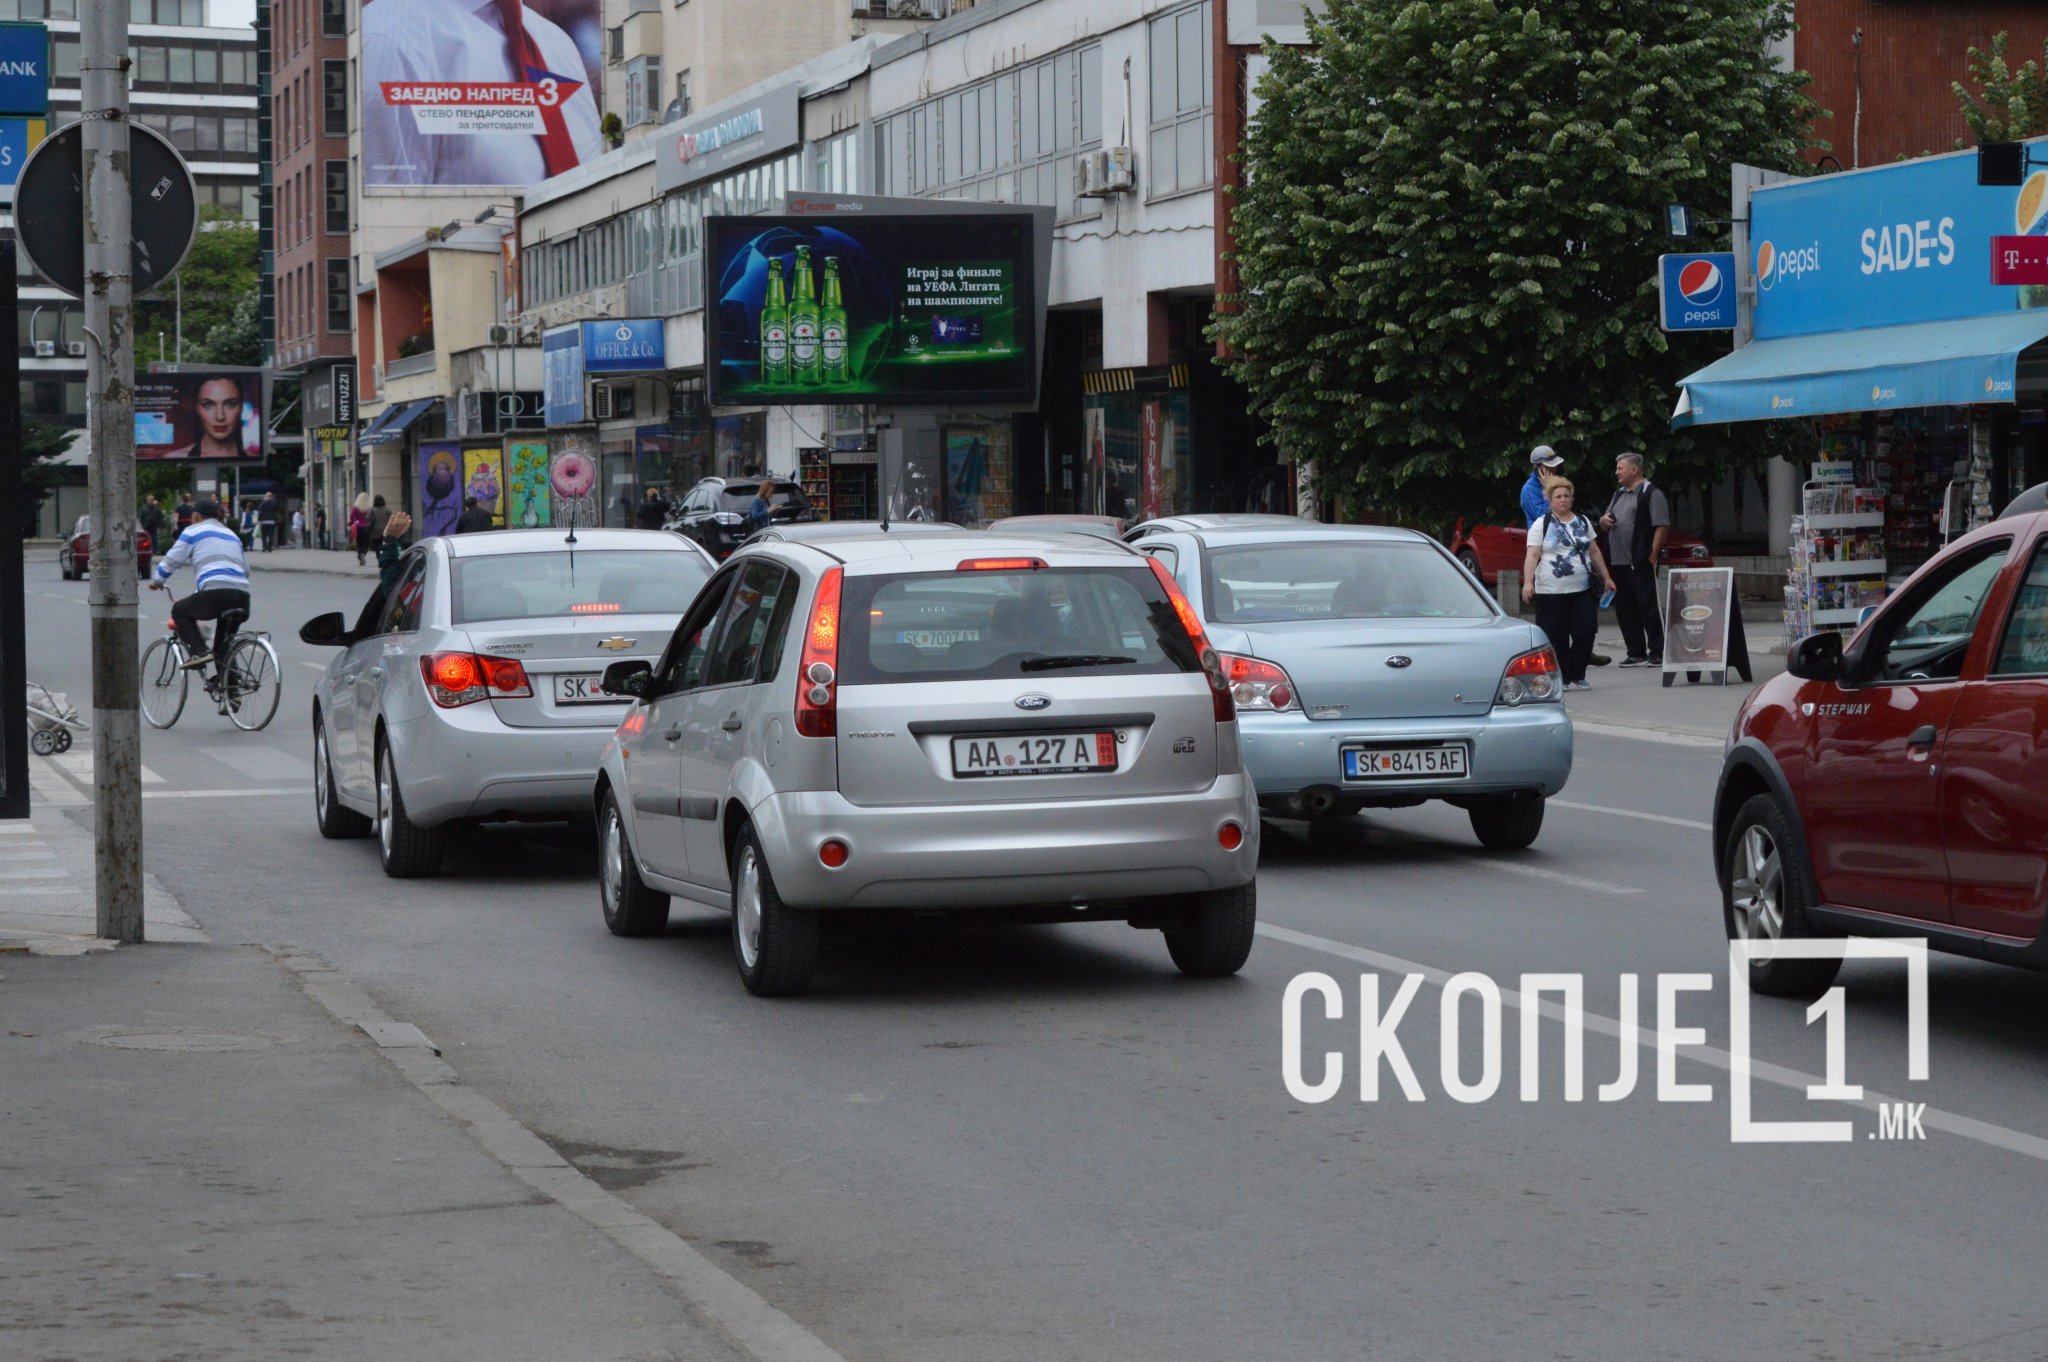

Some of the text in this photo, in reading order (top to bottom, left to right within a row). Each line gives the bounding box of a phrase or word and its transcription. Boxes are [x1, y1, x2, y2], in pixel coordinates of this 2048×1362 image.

[390, 78, 559, 106] ЗАЕДНО НАПРЕД 3
[419, 109, 535, 119] СТЕВО ПЕНДАРОВСКИ
[472, 122, 534, 131] претседател
[1860, 217, 1955, 275] SADE-S
[1778, 241, 1819, 283] pepsi
[907, 267, 1002, 280] Играј за финале
[907, 281, 1000, 292] на УЕФА Лигата
[907, 294, 1003, 306] на шампионите!
[1685, 309, 1720, 323] pepsi
[596, 341, 655, 358] OFFICE & Co.
[1993, 379, 2012, 392] pepsi
[340, 374, 350, 421] NATUZZI
[1879, 388, 1896, 399] pepsi
[1779, 397, 1794, 409] pepsi
[564, 678, 587, 698] SK
[1023, 696, 1044, 707] Ford
[1817, 704, 1871, 716] STEPWAY
[968, 737, 1090, 767] AA 127 A
[1359, 751, 1459, 773] SK 8415 AF
